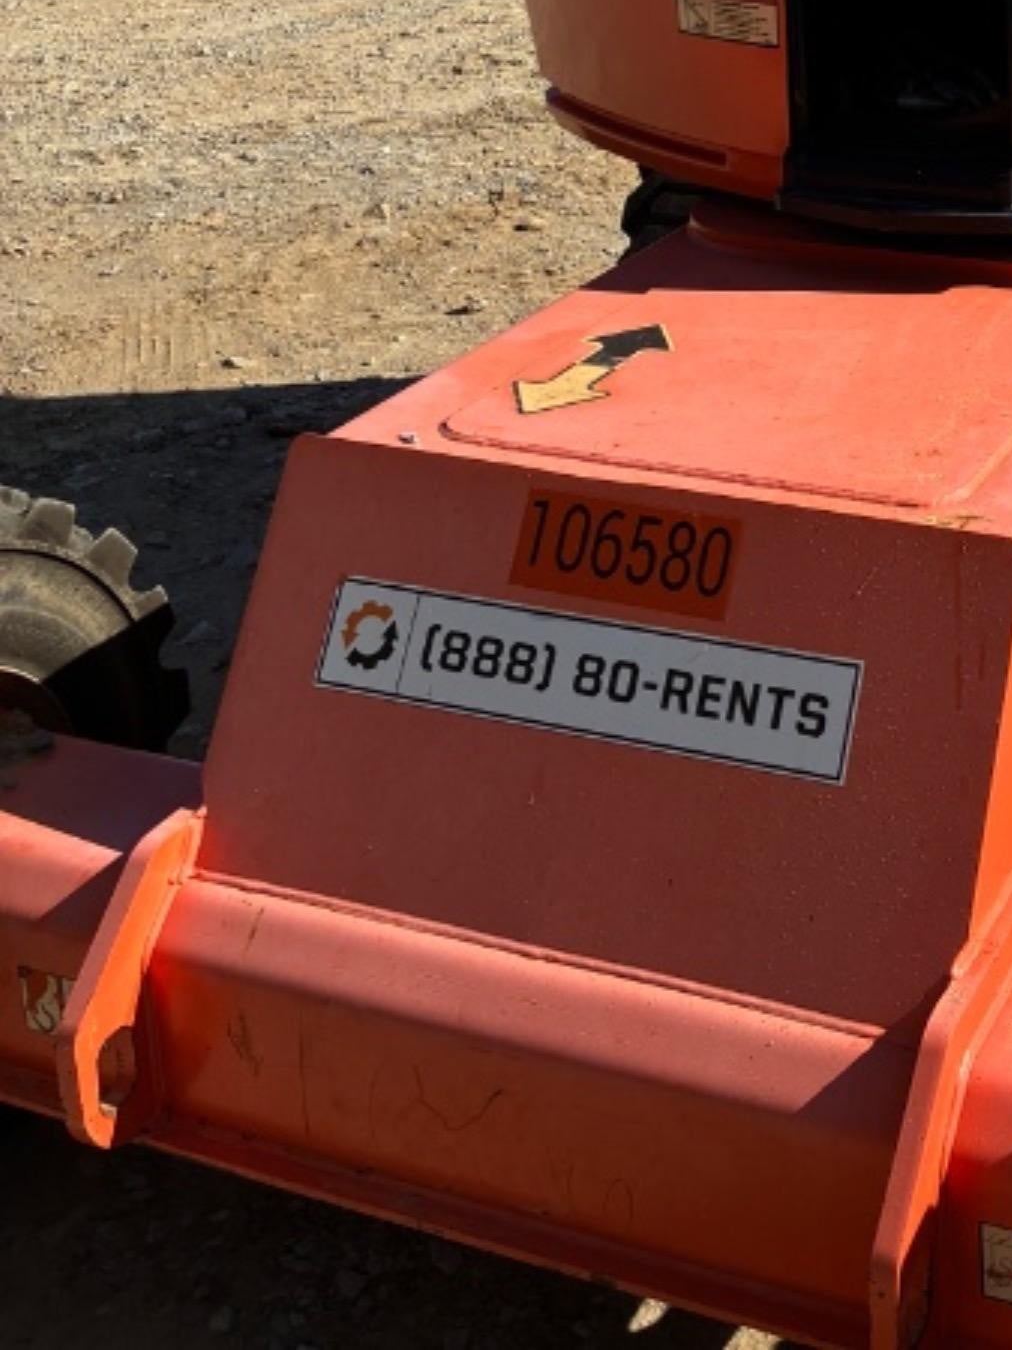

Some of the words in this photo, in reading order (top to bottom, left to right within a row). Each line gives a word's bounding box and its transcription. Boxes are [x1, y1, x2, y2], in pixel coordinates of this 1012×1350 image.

[526, 500, 733, 597] 106580
[420, 623, 556, 693] (888)
[572, 653, 829, 739] 80-RENTS
